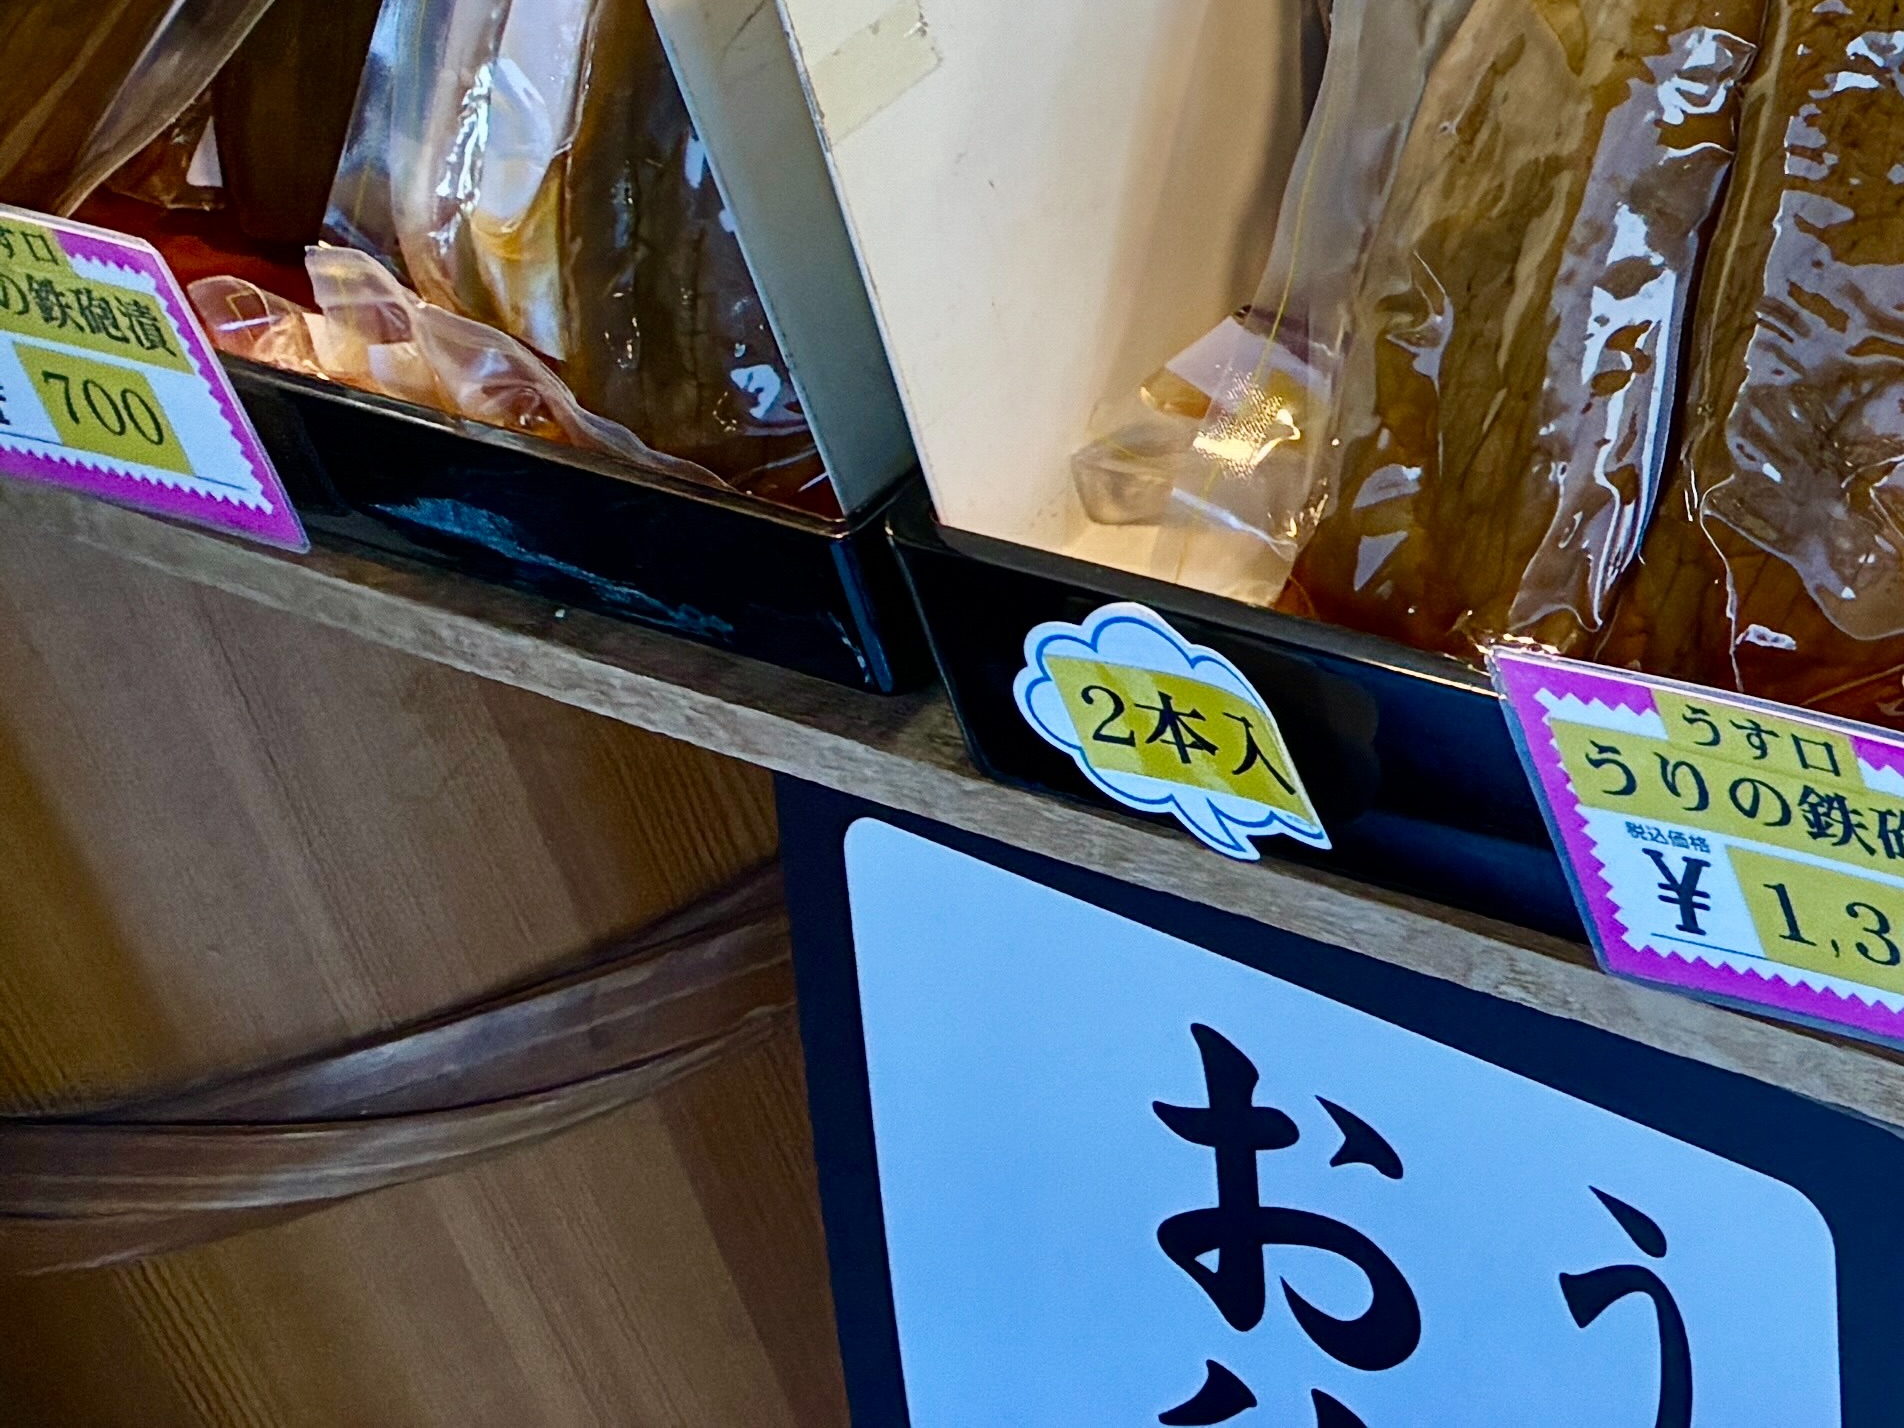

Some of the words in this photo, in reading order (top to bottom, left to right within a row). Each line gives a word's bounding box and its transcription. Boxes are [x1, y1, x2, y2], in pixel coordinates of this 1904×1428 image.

[41, 370, 165, 446] 700
[1080, 684, 1297, 796] 2本入
[1681, 704, 1842, 778] うす口
[1625, 820, 1712, 855] 税込価格
[1642, 848, 1711, 937] ¥
[1152, 1022, 1423, 1428] お
